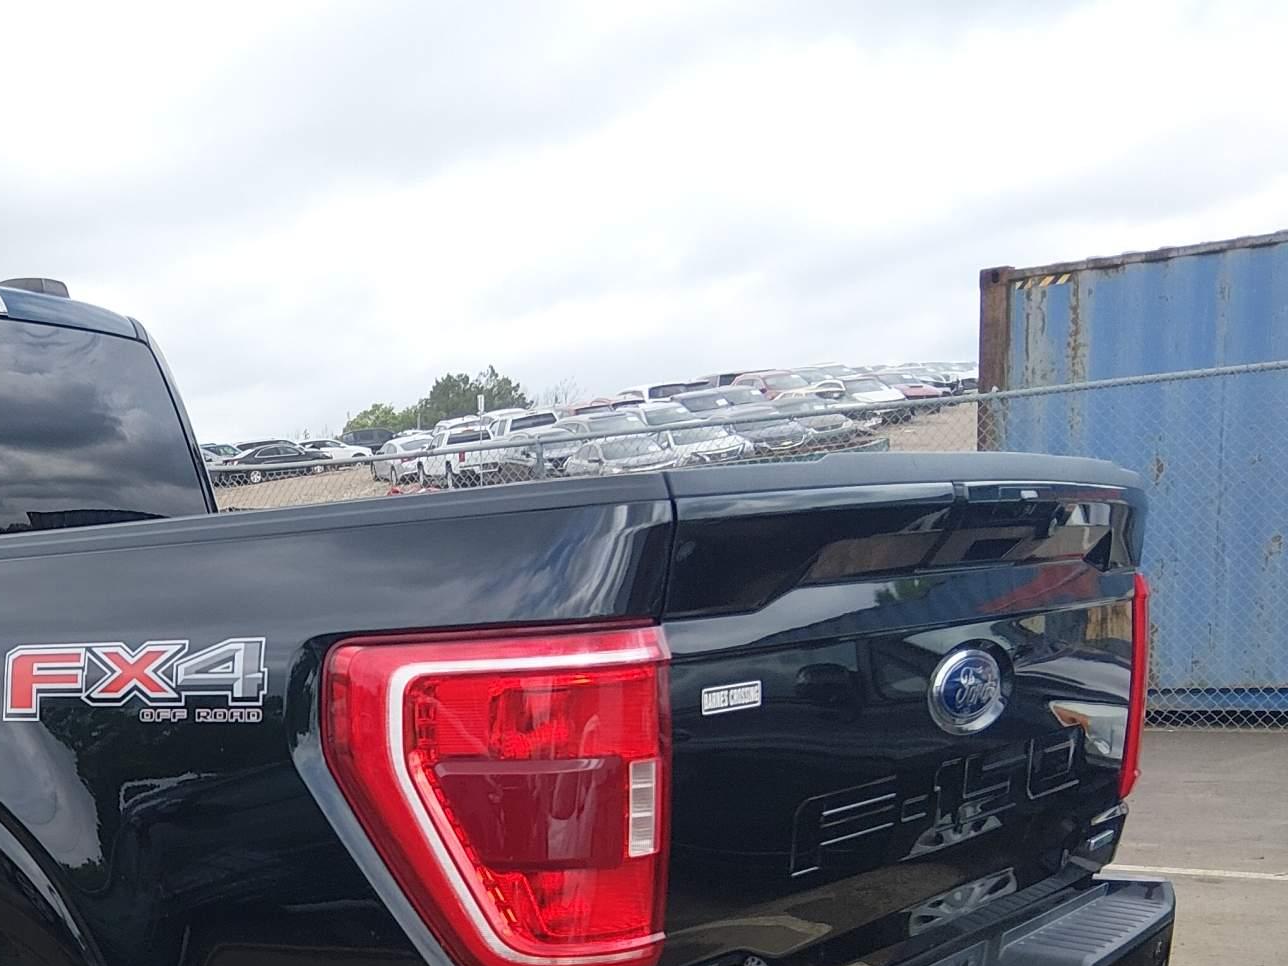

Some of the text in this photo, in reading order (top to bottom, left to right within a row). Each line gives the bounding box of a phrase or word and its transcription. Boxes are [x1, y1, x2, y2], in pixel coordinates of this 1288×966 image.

[2, 637, 268, 721] FX4
[955, 665, 997, 709] Ford
[139, 707, 264, 723] OFF ROAD
[789, 736, 1082, 877] F-150
